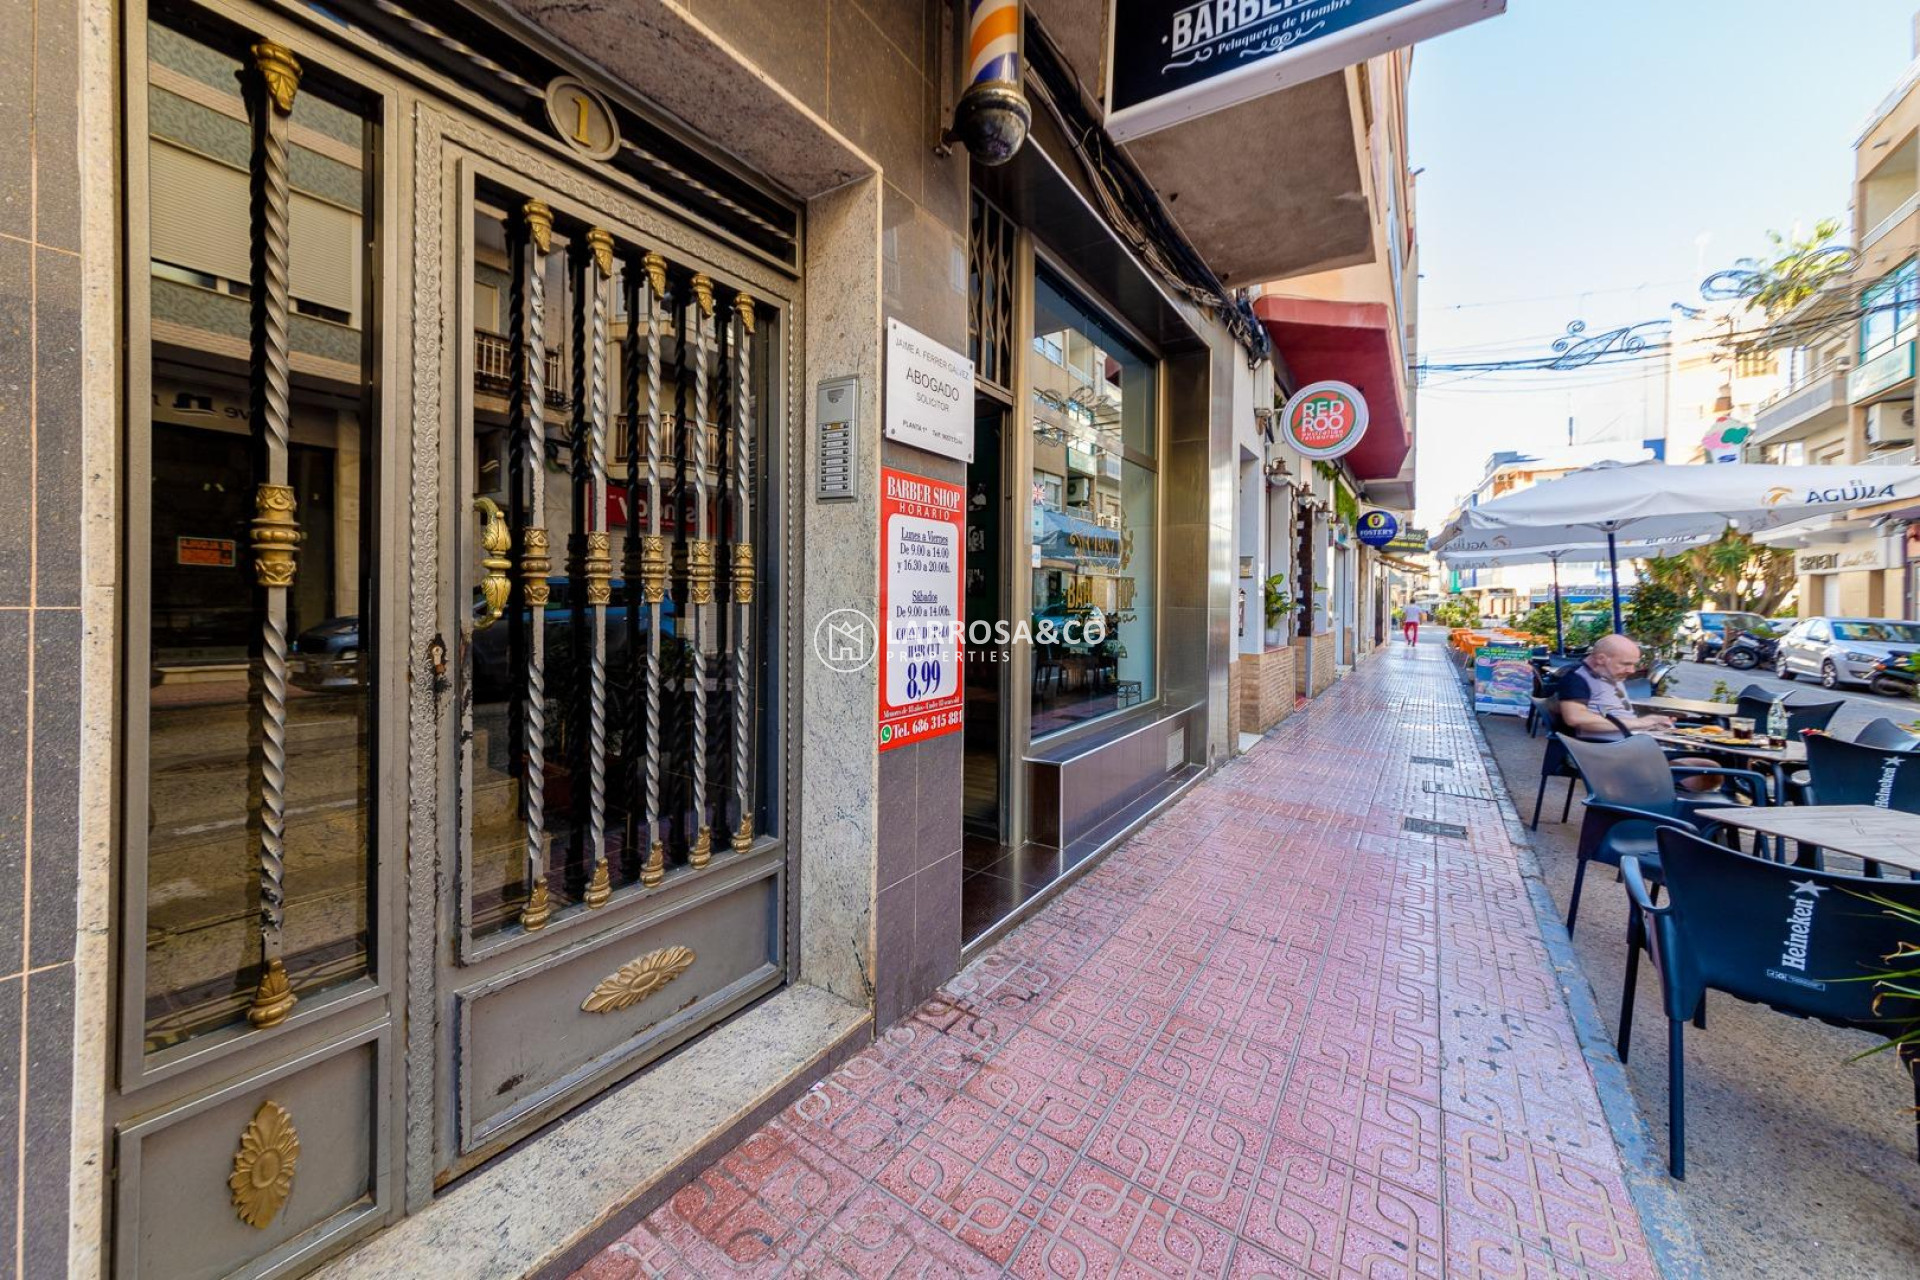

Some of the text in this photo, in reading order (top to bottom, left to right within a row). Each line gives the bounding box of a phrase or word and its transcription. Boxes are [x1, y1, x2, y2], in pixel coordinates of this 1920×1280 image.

[1282, 17, 1297, 30] de
[571, 96, 591, 148] 1
[906, 367, 960, 402] ABOGADO
[916, 391, 950, 412] SOLICITOR
[1302, 399, 1345, 418] RED
[1301, 415, 1345, 432] ROO
[887, 475, 961, 509] BARBER SHOP
[1805, 484, 1897, 504] AGUILA
[899, 502, 951, 521] HORARIO
[901, 526, 921, 542] Lunes
[927, 530, 949, 545] Viernes
[900, 542, 909, 555] De
[910, 544, 925, 557] 9.00
[933, 546, 949, 559] 14.00
[904, 559, 922, 572] 16.30
[896, 605, 906, 618] De
[907, 605, 922, 618] 9.00
[906, 659, 942, 700] 8,99
[892, 709, 962, 739] Tel. 686 315 881
[1875, 767, 1897, 808] Heineken
[1782, 897, 1815, 972] Heineken
